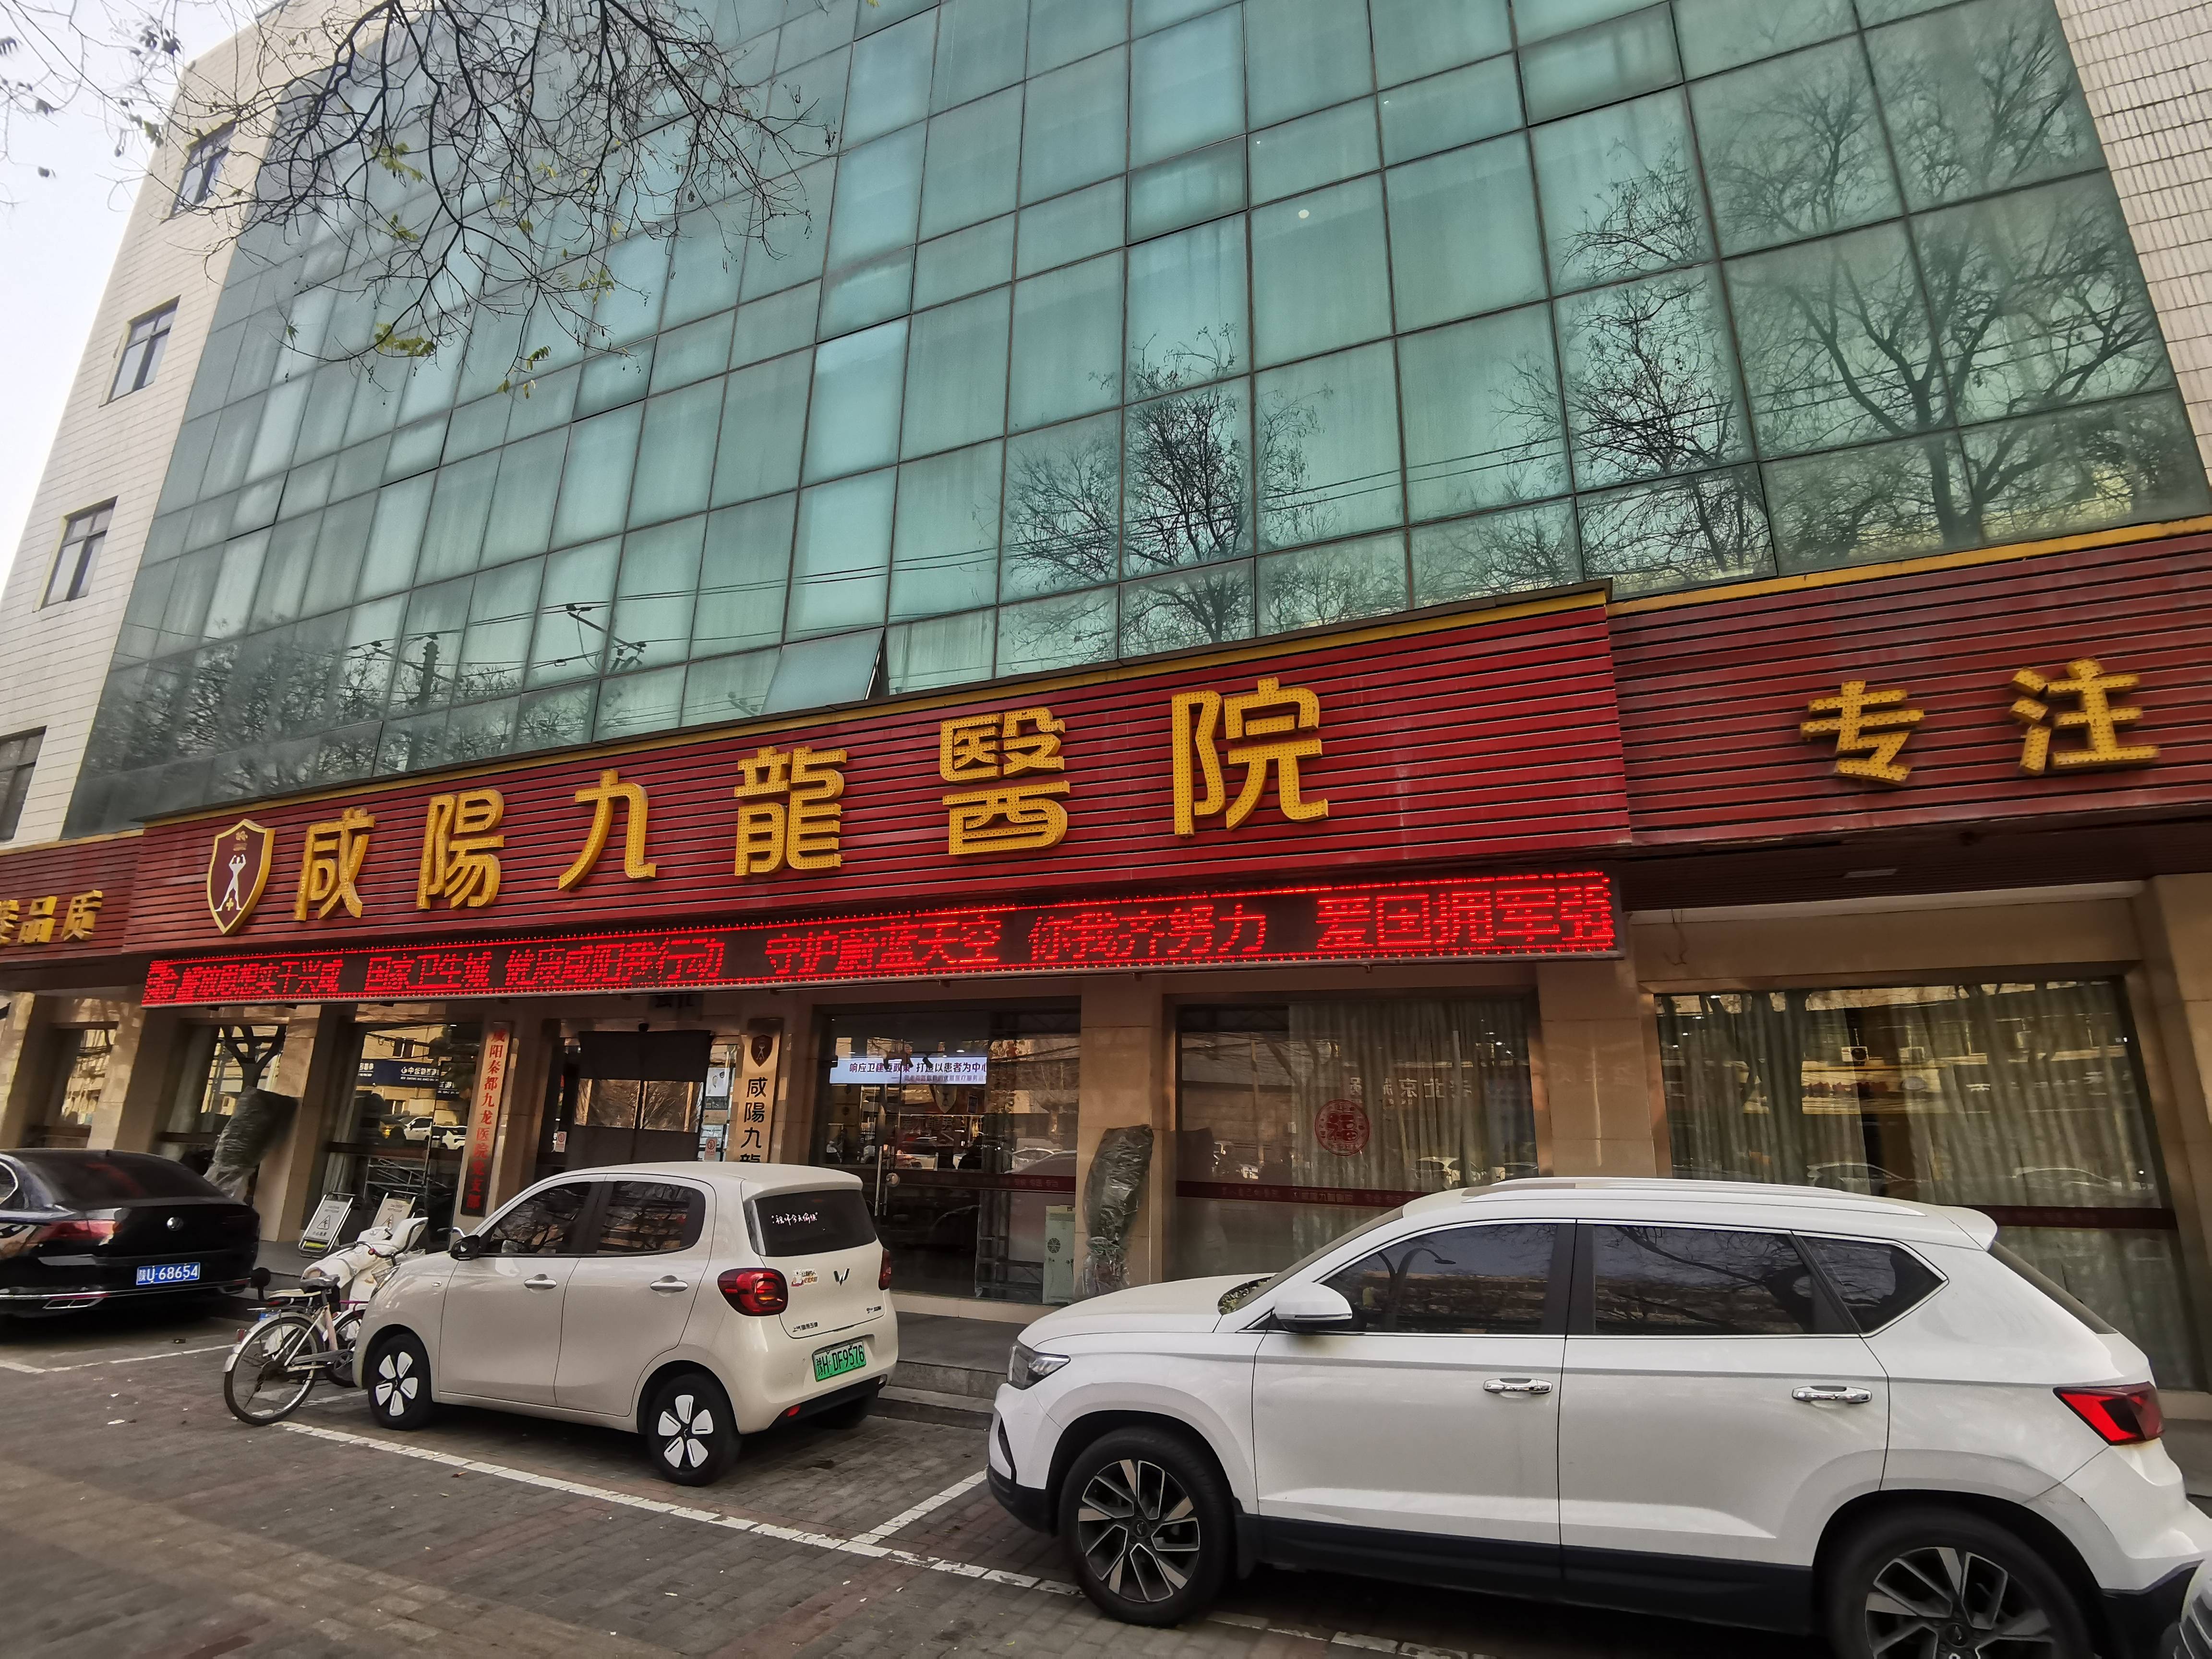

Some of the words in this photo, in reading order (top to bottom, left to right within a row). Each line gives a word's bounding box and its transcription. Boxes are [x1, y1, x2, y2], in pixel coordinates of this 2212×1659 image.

[1800, 657, 2160, 787] 专注
[294, 676, 1329, 921] 咸陽九龍醫院
[765, 914, 1001, 974] 守护蔚蓝天空
[1028, 903, 1266, 961] 你我齐努力
